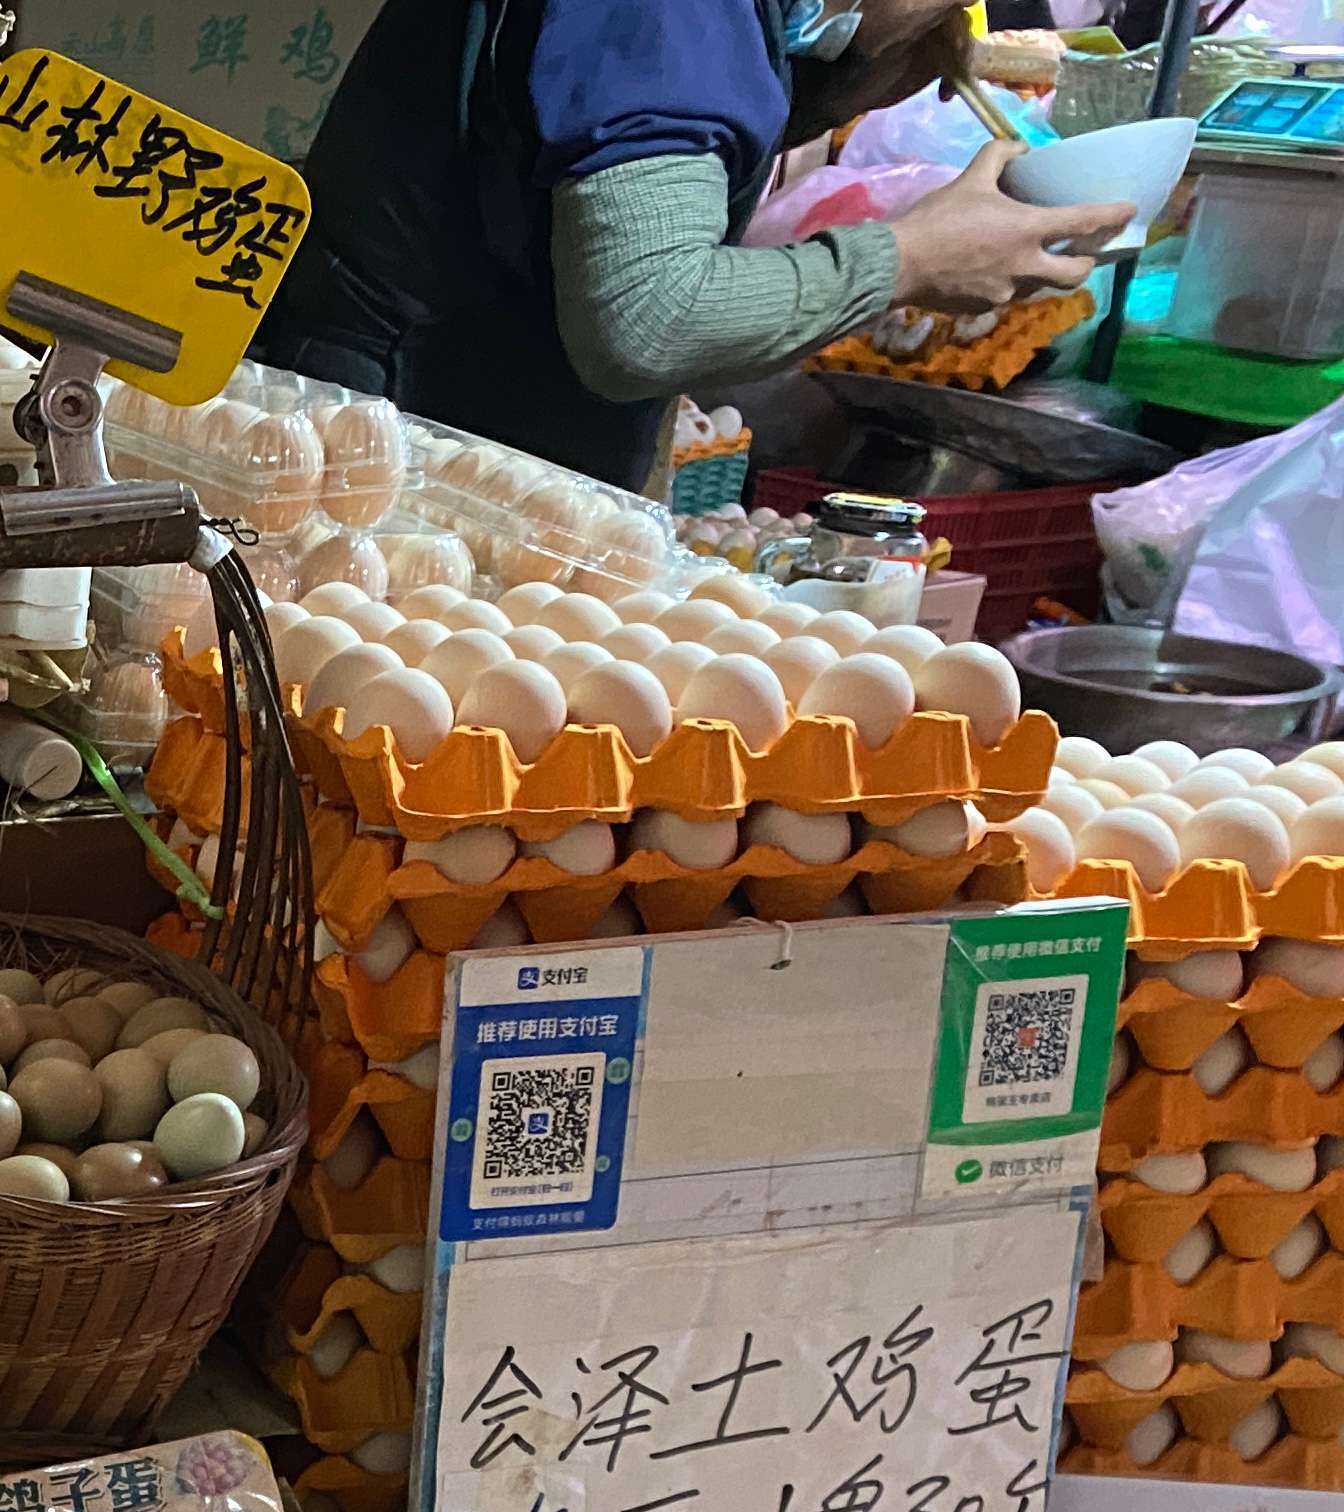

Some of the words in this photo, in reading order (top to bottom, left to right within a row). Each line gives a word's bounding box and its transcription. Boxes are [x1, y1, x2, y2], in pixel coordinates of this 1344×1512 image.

[541, 967, 589, 986] 支付宝
[477, 1015, 619, 1043] 推荐使用支付宝
[990, 1156, 1064, 1178] 微信支付
[461, 1299, 1071, 1472] 会泽土鸡蛋
